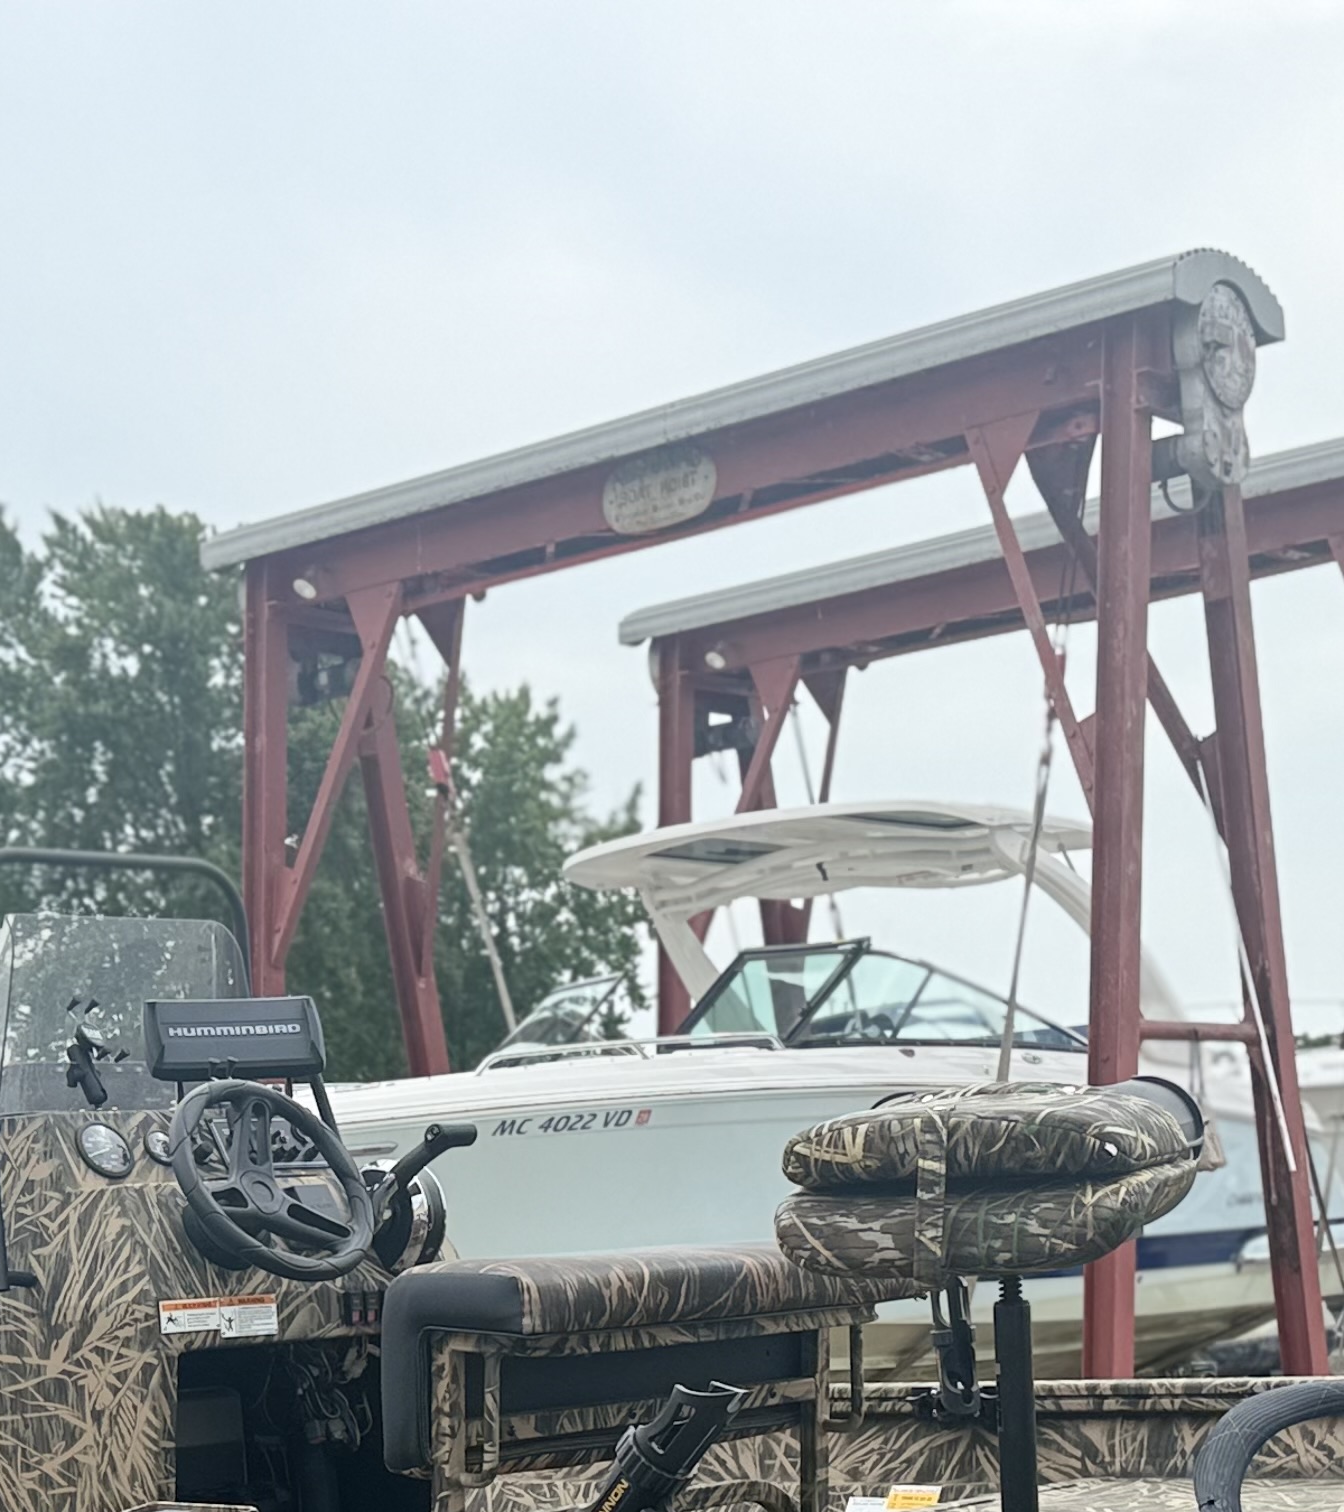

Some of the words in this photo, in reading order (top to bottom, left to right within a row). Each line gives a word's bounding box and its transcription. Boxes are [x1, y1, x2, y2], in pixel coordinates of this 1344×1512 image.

[167, 1023, 302, 1038] HUMMINBIRD
[491, 1118, 534, 1137] MC
[538, 1112, 598, 1133] 4022
[601, 1109, 633, 1129] VD
